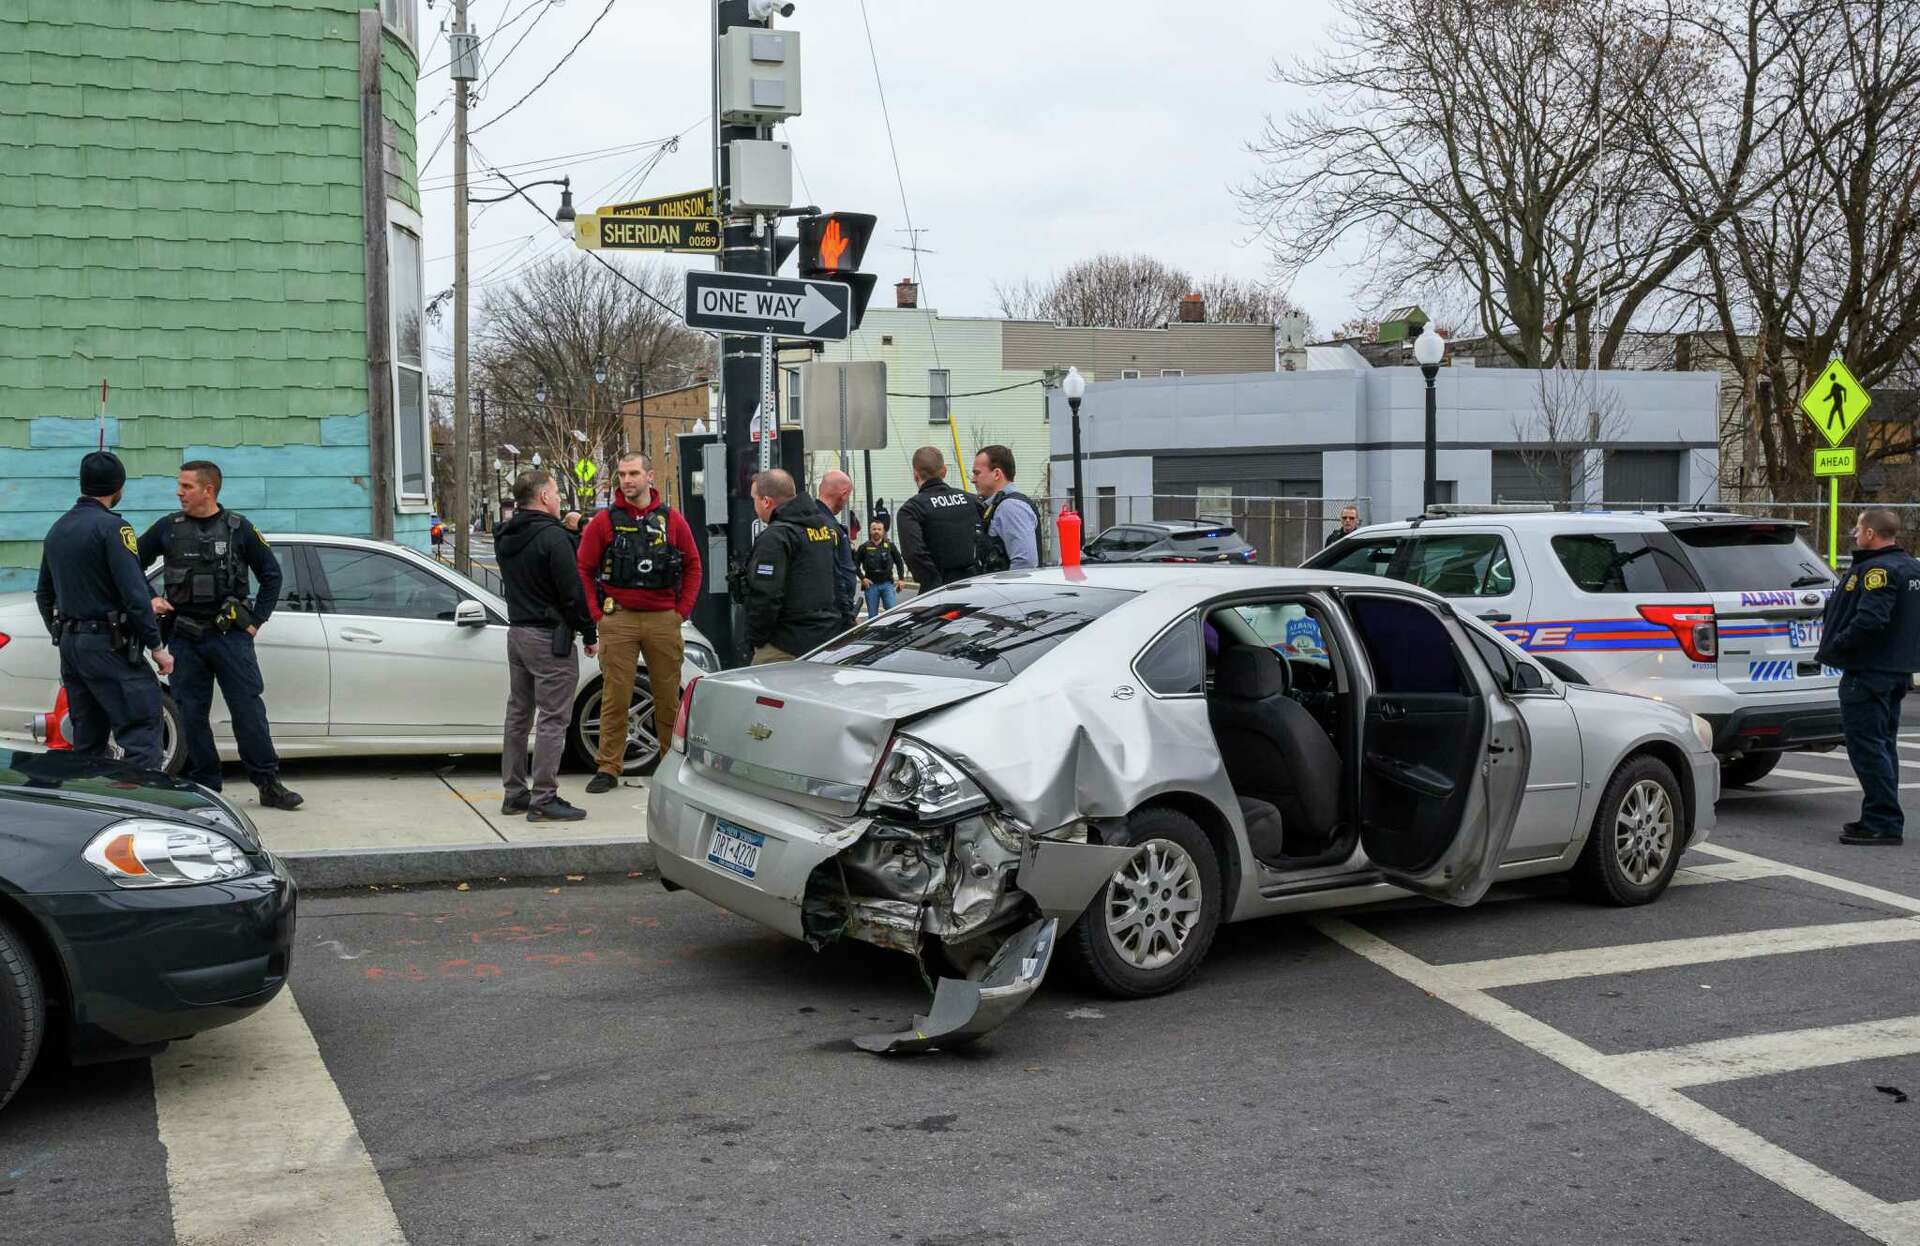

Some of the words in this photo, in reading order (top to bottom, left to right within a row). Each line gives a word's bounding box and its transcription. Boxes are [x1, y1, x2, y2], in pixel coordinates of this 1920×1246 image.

[658, 197, 705, 217] JOHNSON
[604, 223, 681, 244] SHERIDAN
[694, 222, 710, 233] AVE
[688, 236, 717, 247] 00289
[703, 291, 748, 314] ONE
[756, 293, 801, 318] WAY
[1820, 456, 1850, 467] AHEAD
[930, 493, 968, 508] POLICE
[1741, 591, 1797, 607] ALBANY
[1798, 621, 1824, 642] 577
